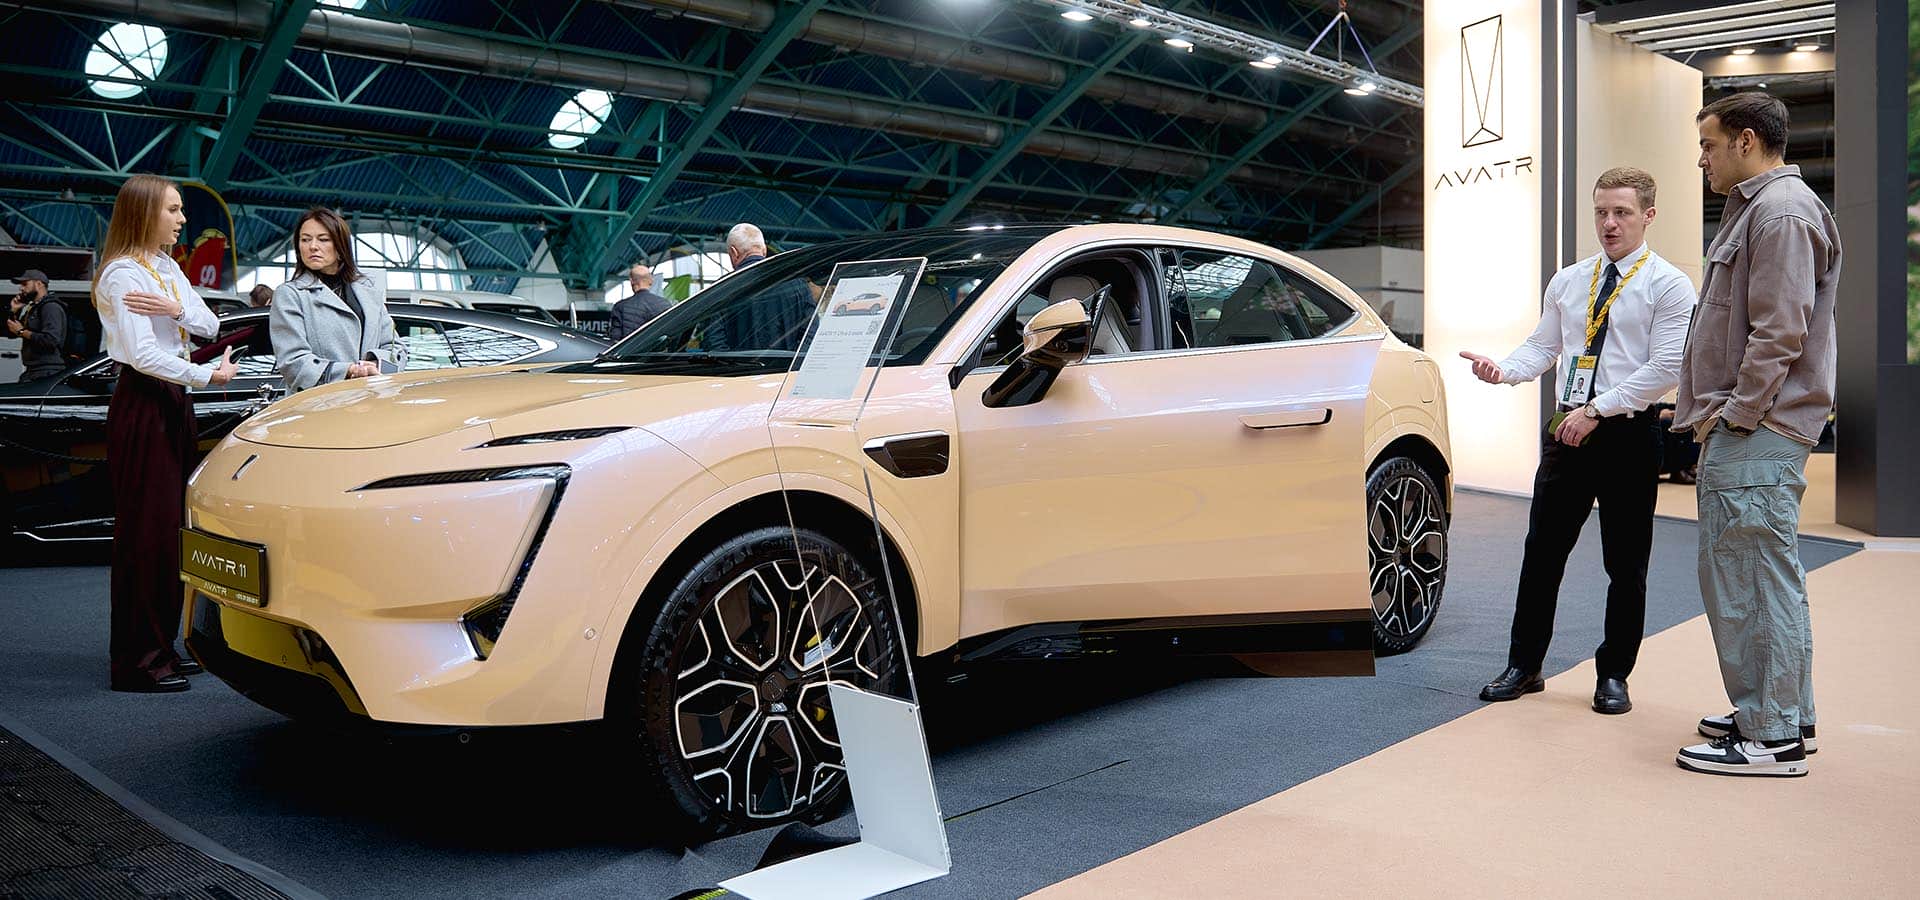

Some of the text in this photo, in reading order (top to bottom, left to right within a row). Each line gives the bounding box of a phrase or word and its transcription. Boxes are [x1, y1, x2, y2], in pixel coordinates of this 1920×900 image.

[1434, 156, 1533, 191] AVATR
[191, 549, 248, 579] AVATR 11
[203, 580, 228, 597] AVATR
